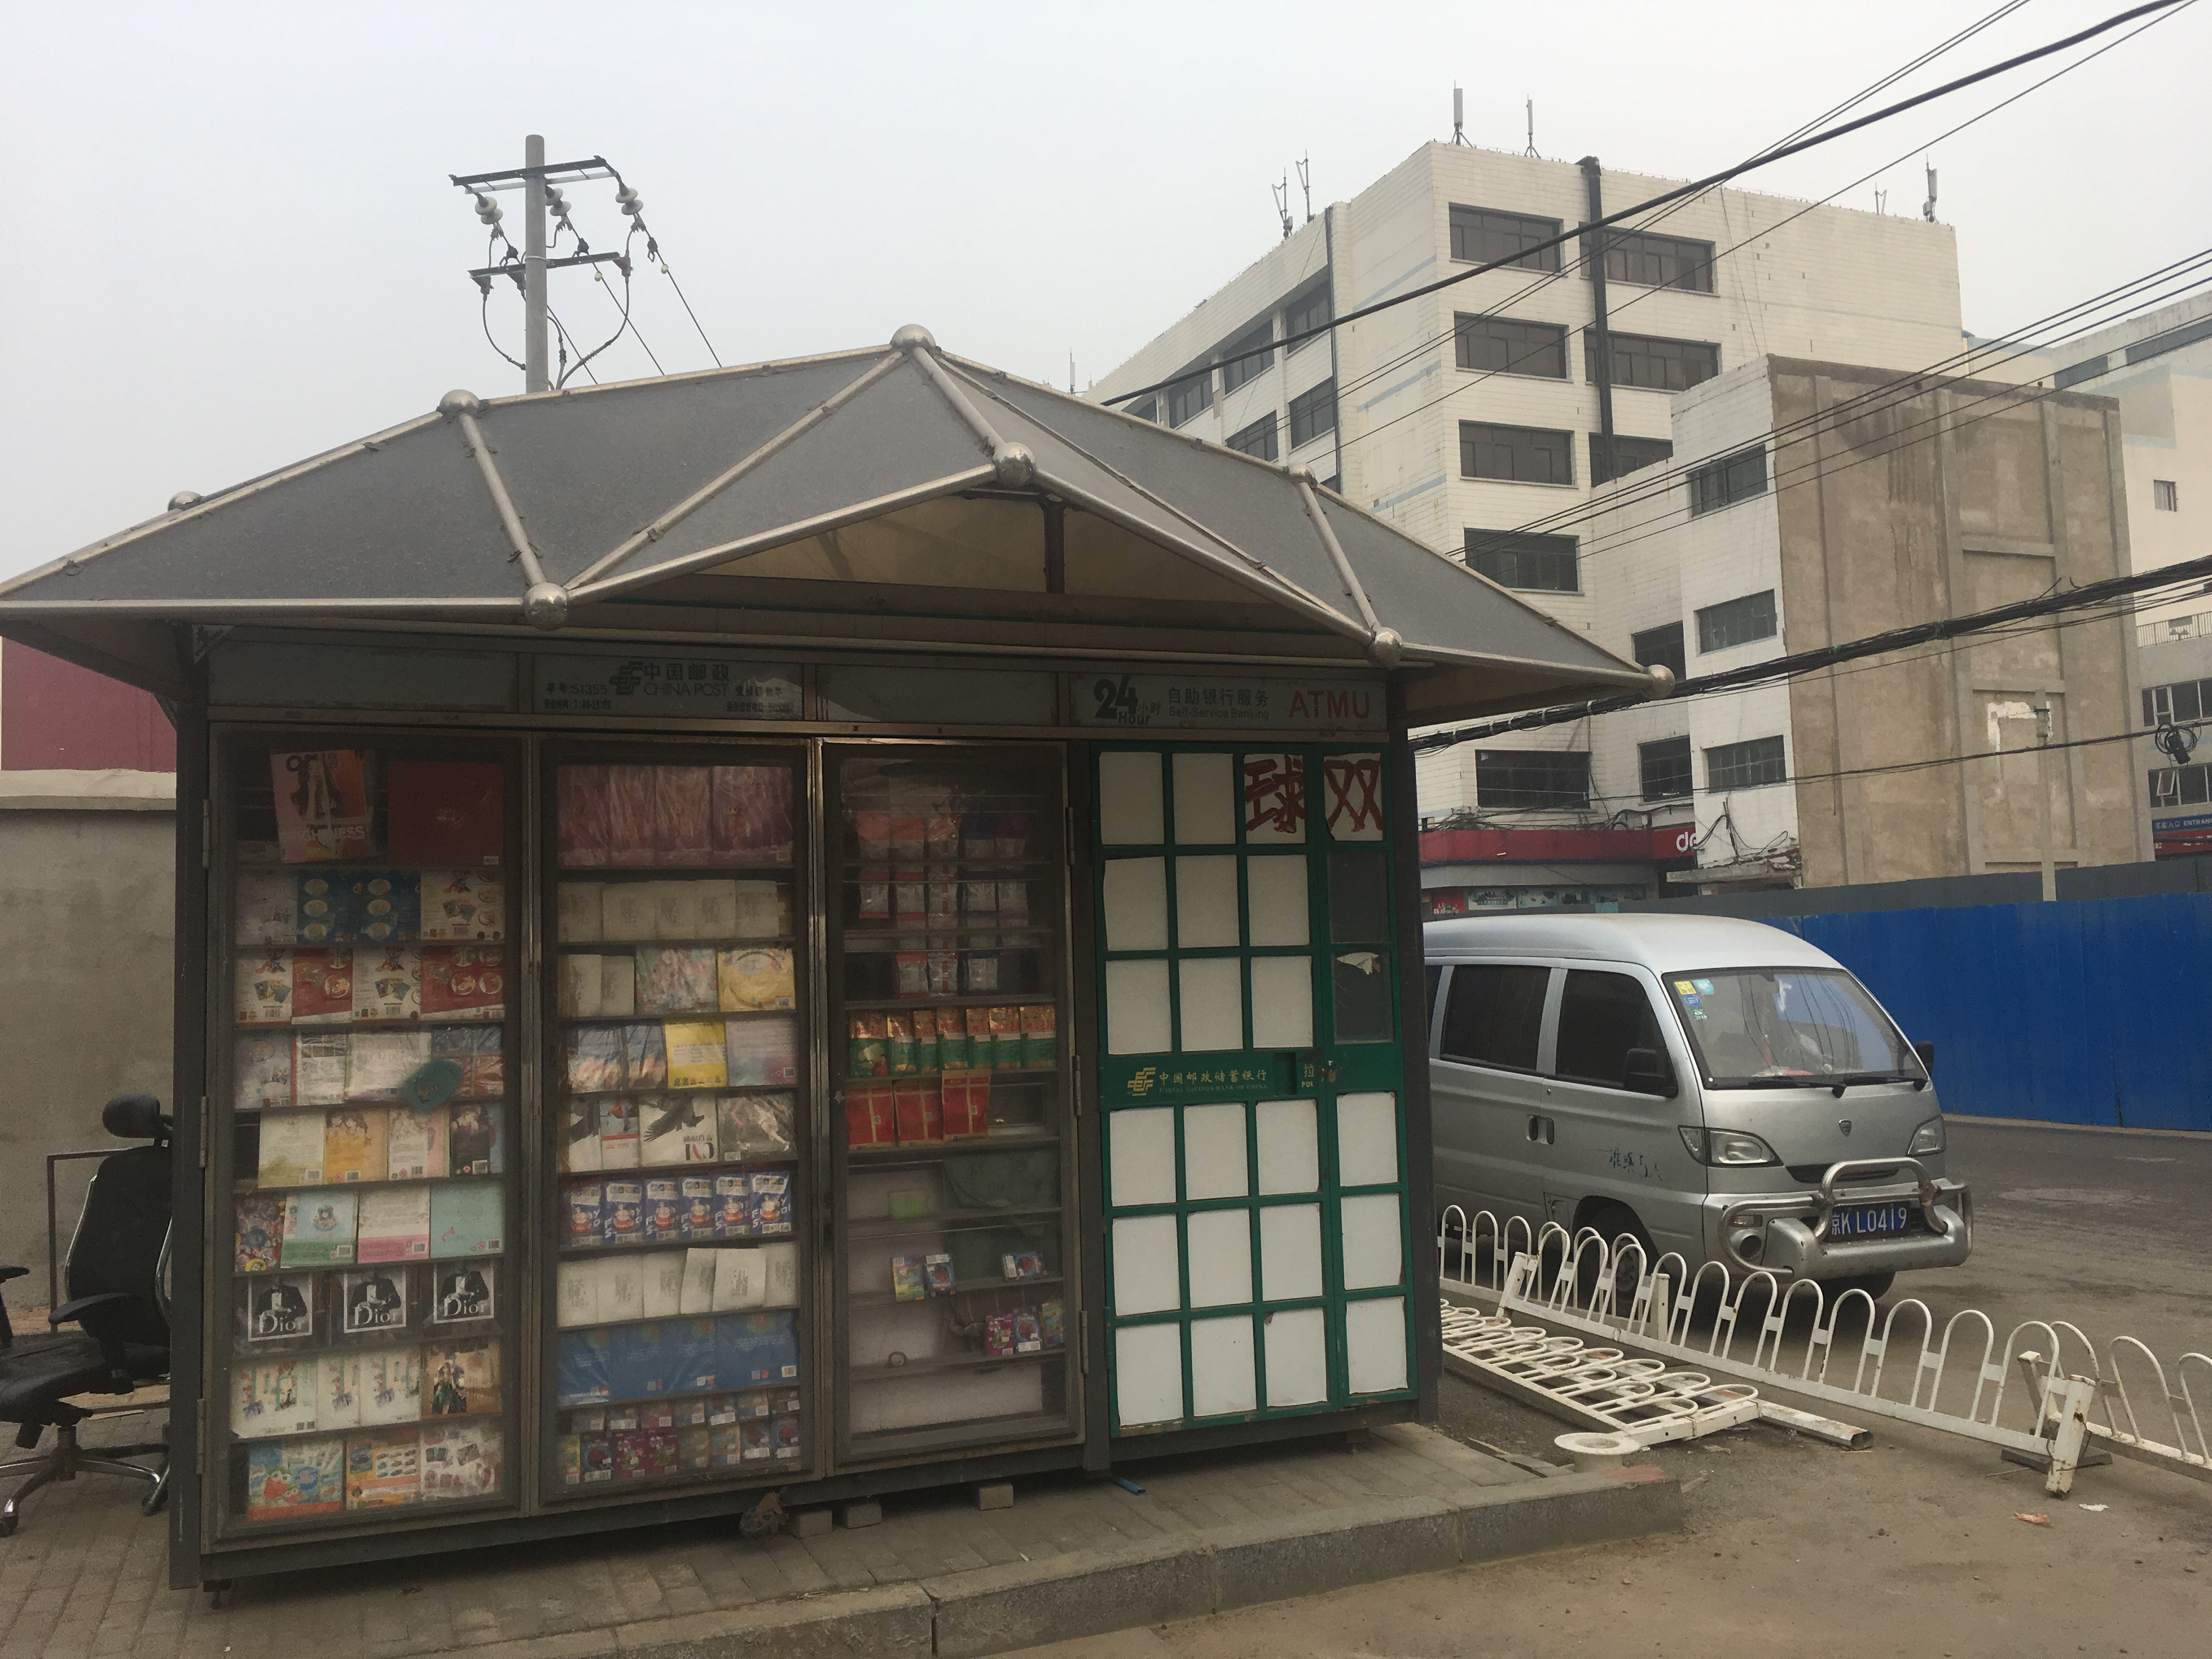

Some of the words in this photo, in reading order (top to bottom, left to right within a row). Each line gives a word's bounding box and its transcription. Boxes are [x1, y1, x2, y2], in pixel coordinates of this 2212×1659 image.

[644, 662, 729, 681] 中国邮政
[644, 683, 691, 696] CHINA
[694, 683, 729, 697] POST
[1093, 674, 1138, 719] 24
[1169, 687, 1268, 707] 自助银行服务
[1138, 701, 1161, 715] 小时
[1169, 707, 1228, 718] Self-Service
[1231, 708, 1270, 721] Banking
[1288, 690, 1370, 719] ATMU
[1119, 712, 1150, 725] Hour
[1159, 1069, 1267, 1086] 中国邮政储蓄银行
[1304, 1064, 1314, 1078] 拉
[1831, 1207, 1908, 1235] 京KL0419
[353, 1304, 398, 1326] Dior
[443, 1296, 488, 1317] Dior
[256, 1311, 306, 1334] Dior
